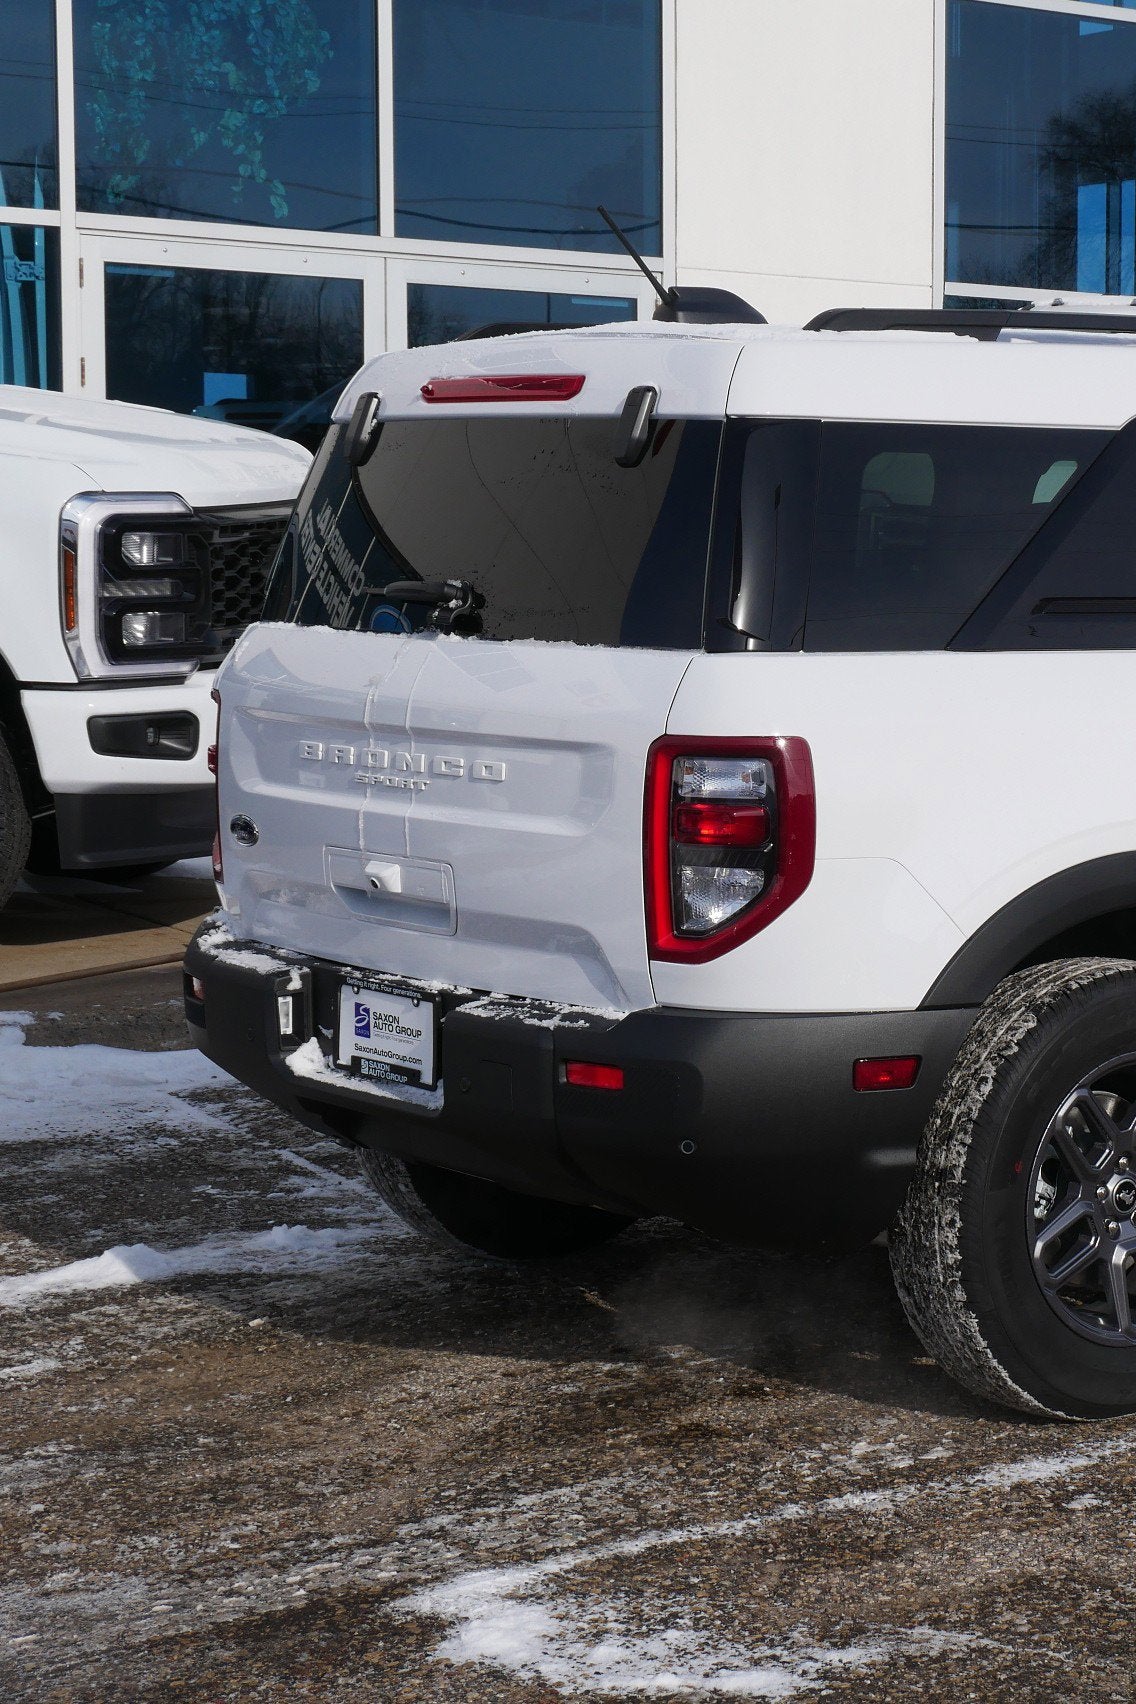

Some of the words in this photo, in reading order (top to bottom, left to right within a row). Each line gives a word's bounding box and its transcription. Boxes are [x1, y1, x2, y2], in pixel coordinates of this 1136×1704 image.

[299, 740, 506, 781] BRONCO
[354, 772, 430, 791] SPORT
[380, 984, 392, 992] Four
[372, 1011, 400, 1025] SAXON
[373, 1020, 394, 1033] AUTO
[395, 1025, 422, 1038] GROUP
[354, 1043, 423, 1065] SaxonAutoGroup.com
[368, 1060, 390, 1071] SAXON
[368, 1067, 385, 1079] AUTO
[386, 1071, 408, 1083] GROUP
